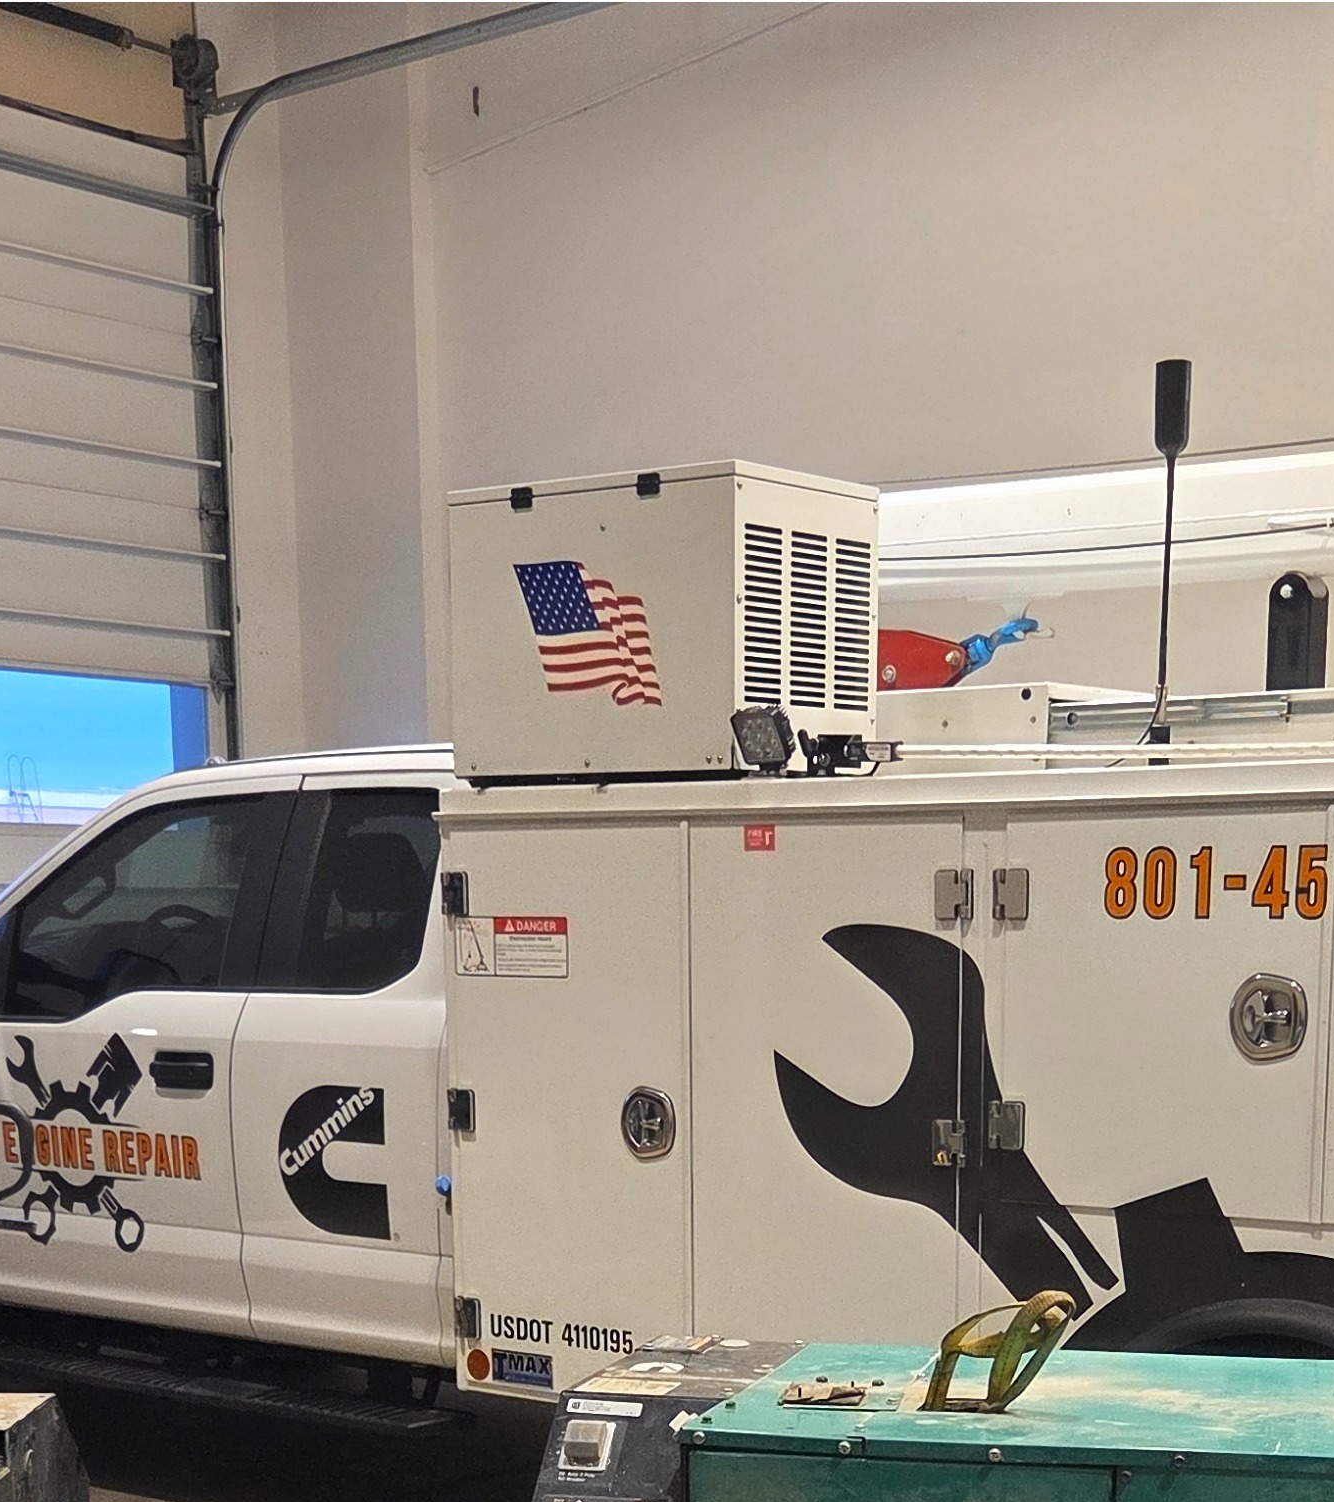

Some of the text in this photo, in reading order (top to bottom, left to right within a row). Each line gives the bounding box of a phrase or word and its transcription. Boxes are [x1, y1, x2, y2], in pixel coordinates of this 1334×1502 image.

[516, 920, 557, 932] DANGER
[2, 1120, 95, 1171] EGINE
[102, 1129, 202, 1181] REPAIR
[280, 1087, 375, 1176] Cummins
[490, 1313, 633, 1355] USDOT 4110195
